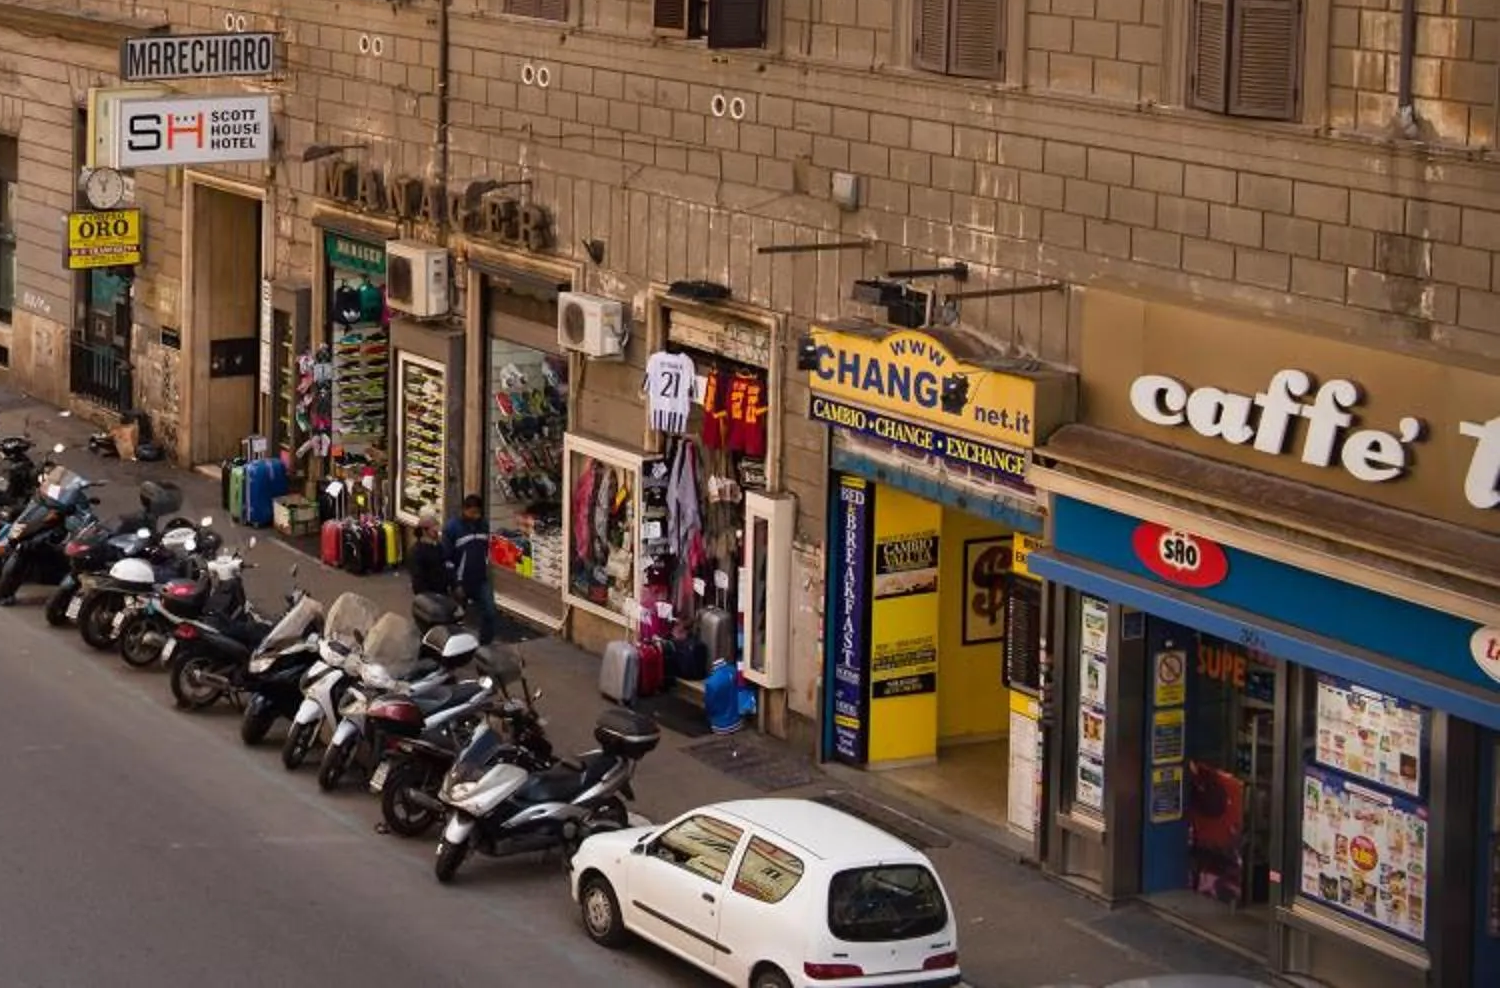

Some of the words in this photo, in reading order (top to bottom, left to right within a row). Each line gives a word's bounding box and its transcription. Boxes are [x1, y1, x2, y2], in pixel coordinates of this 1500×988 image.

[129, 36, 271, 77] MARECHIARO
[211, 110, 256, 122] SCOTT
[211, 124, 261, 136] HOUSE
[211, 137, 257, 150] HOTEL
[79, 219, 129, 238] ORO
[660, 372, 680, 398] 21
[815, 344, 967, 413] CHANG
[974, 405, 1030, 435] net.it
[813, 399, 867, 429] CAMBIO
[875, 417, 934, 450] CHANGE
[946, 438, 1025, 475] EXCHANGE
[840, 486, 866, 505] BED
